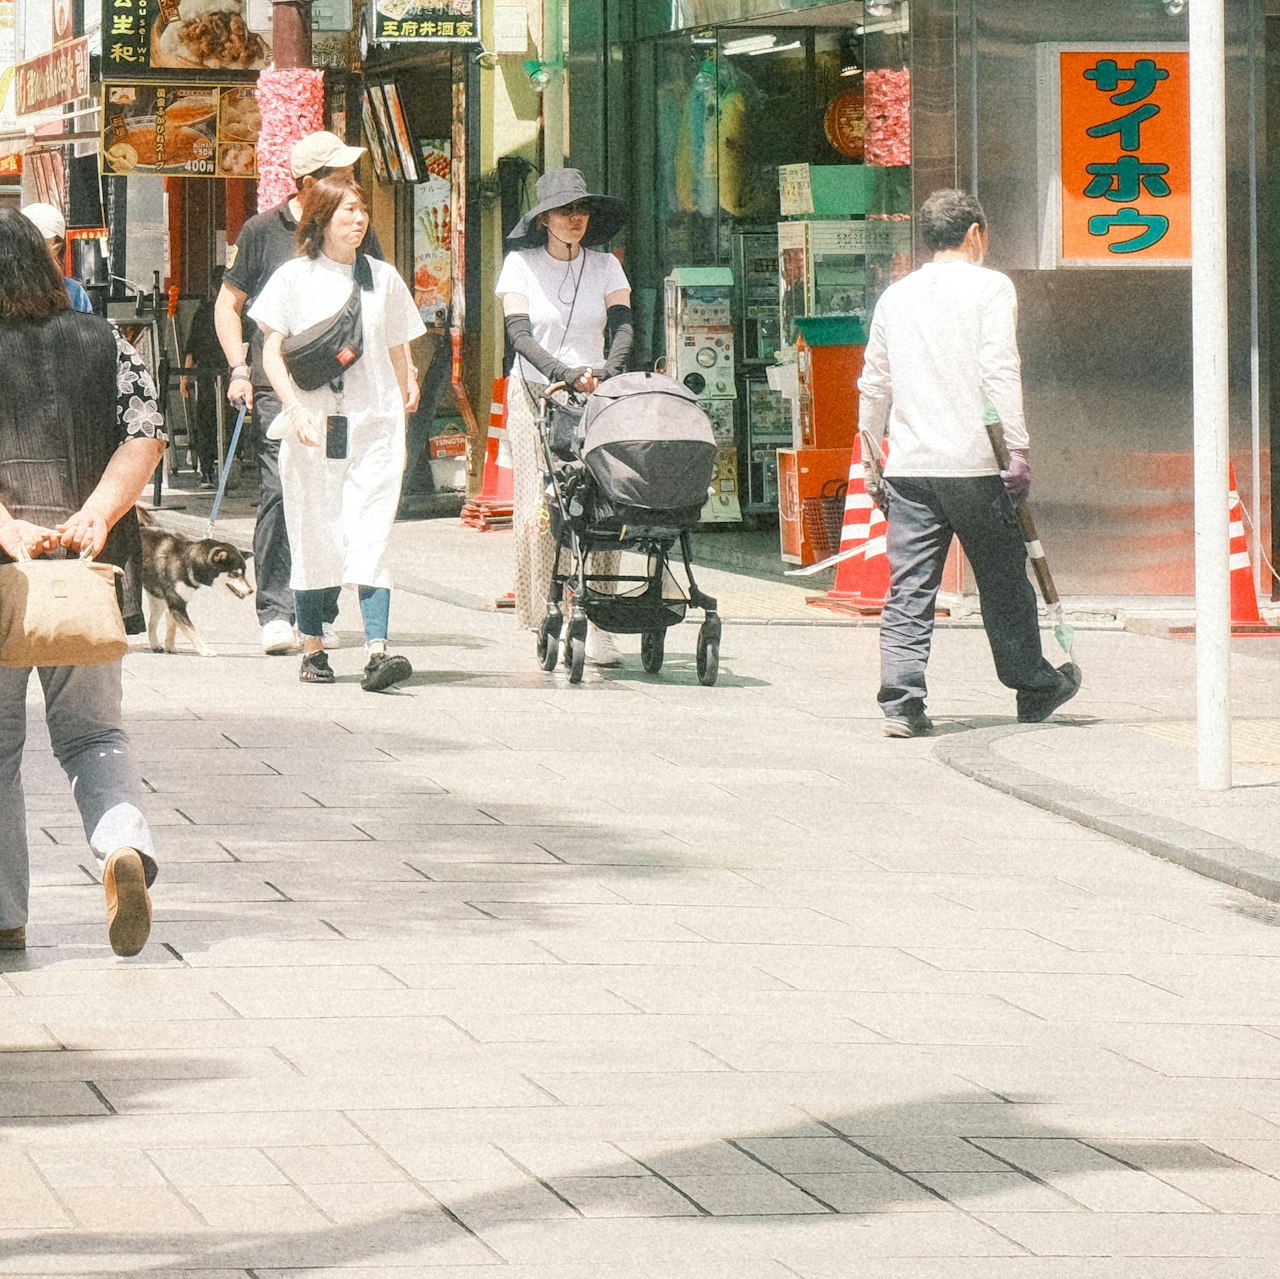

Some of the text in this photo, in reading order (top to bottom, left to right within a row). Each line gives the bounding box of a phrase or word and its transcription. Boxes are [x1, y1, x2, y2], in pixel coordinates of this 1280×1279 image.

[381, 20, 474, 37] 王府井酒家
[1082, 58, 1173, 255] サイホウ
